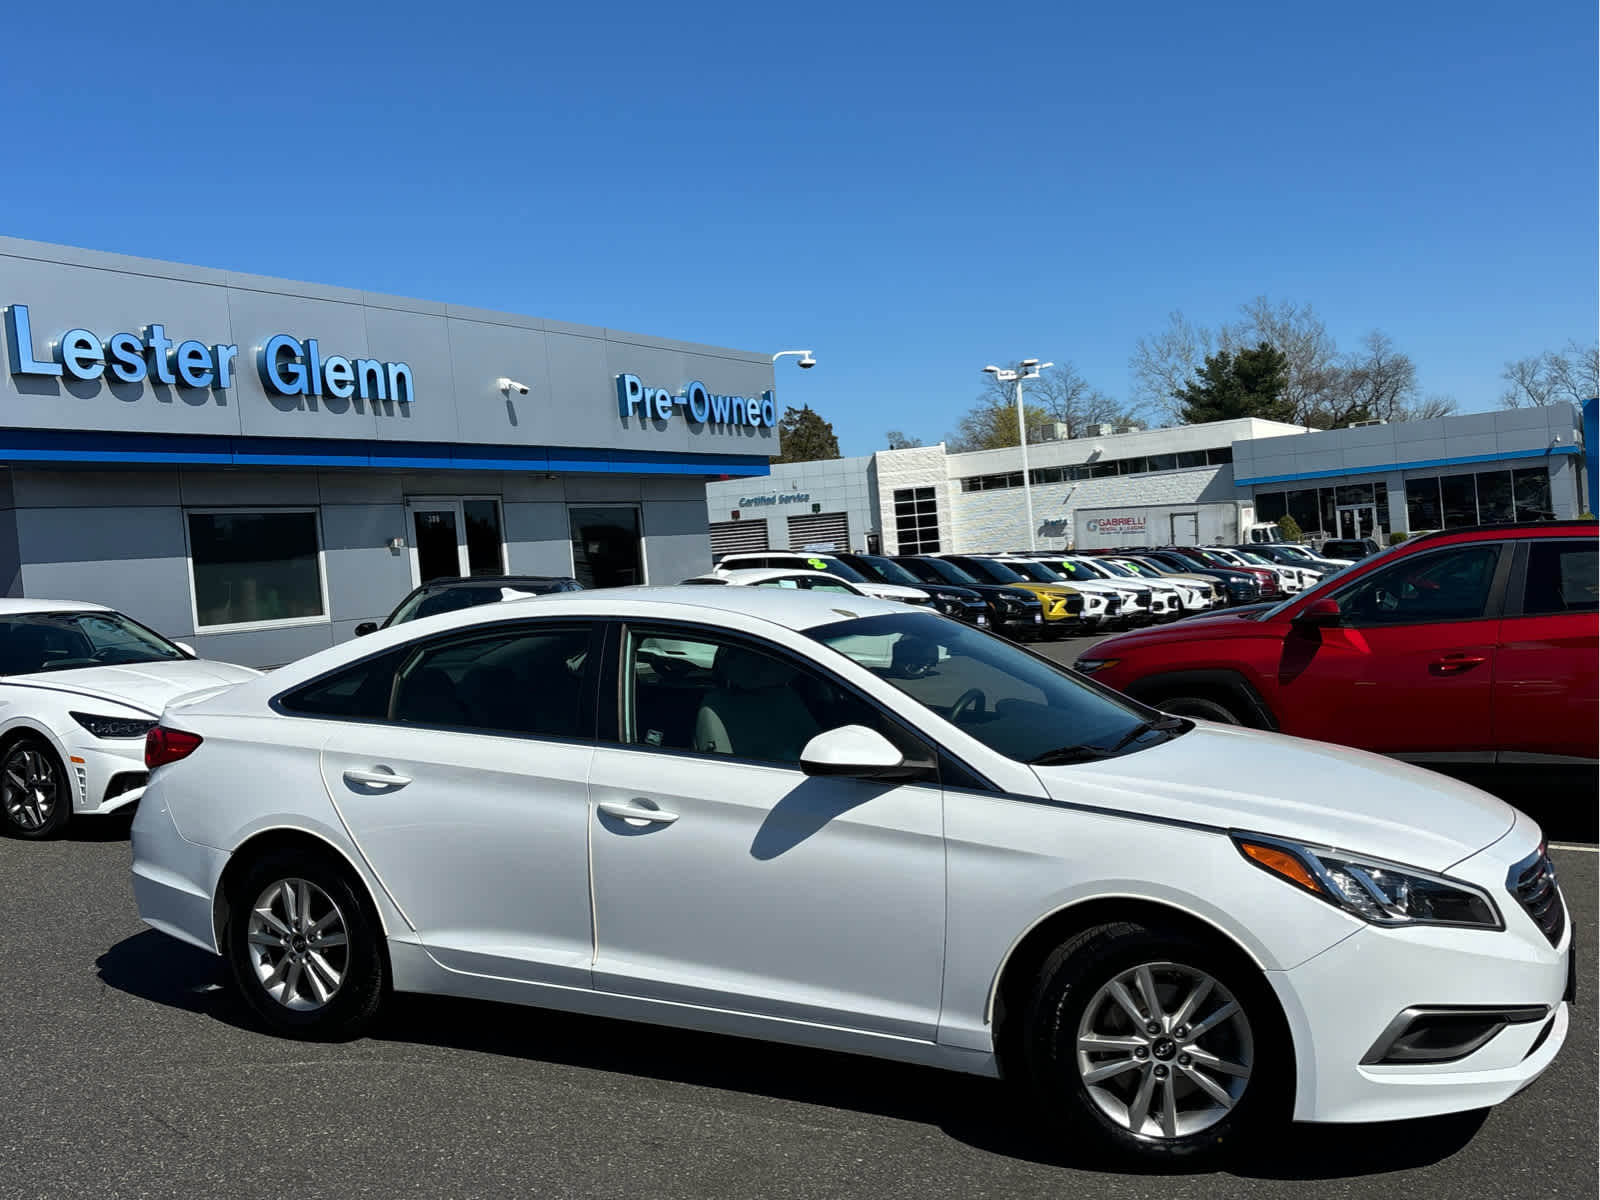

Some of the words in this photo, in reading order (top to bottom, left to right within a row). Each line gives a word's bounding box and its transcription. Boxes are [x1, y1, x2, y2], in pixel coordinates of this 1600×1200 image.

[5, 304, 238, 390] Lester
[259, 333, 415, 403] Glenn
[616, 374, 776, 428] Pre-Owned
[739, 495, 777, 508] Certified
[778, 493, 810, 505] Service
[1099, 517, 1146, 527] GABRIELLI
